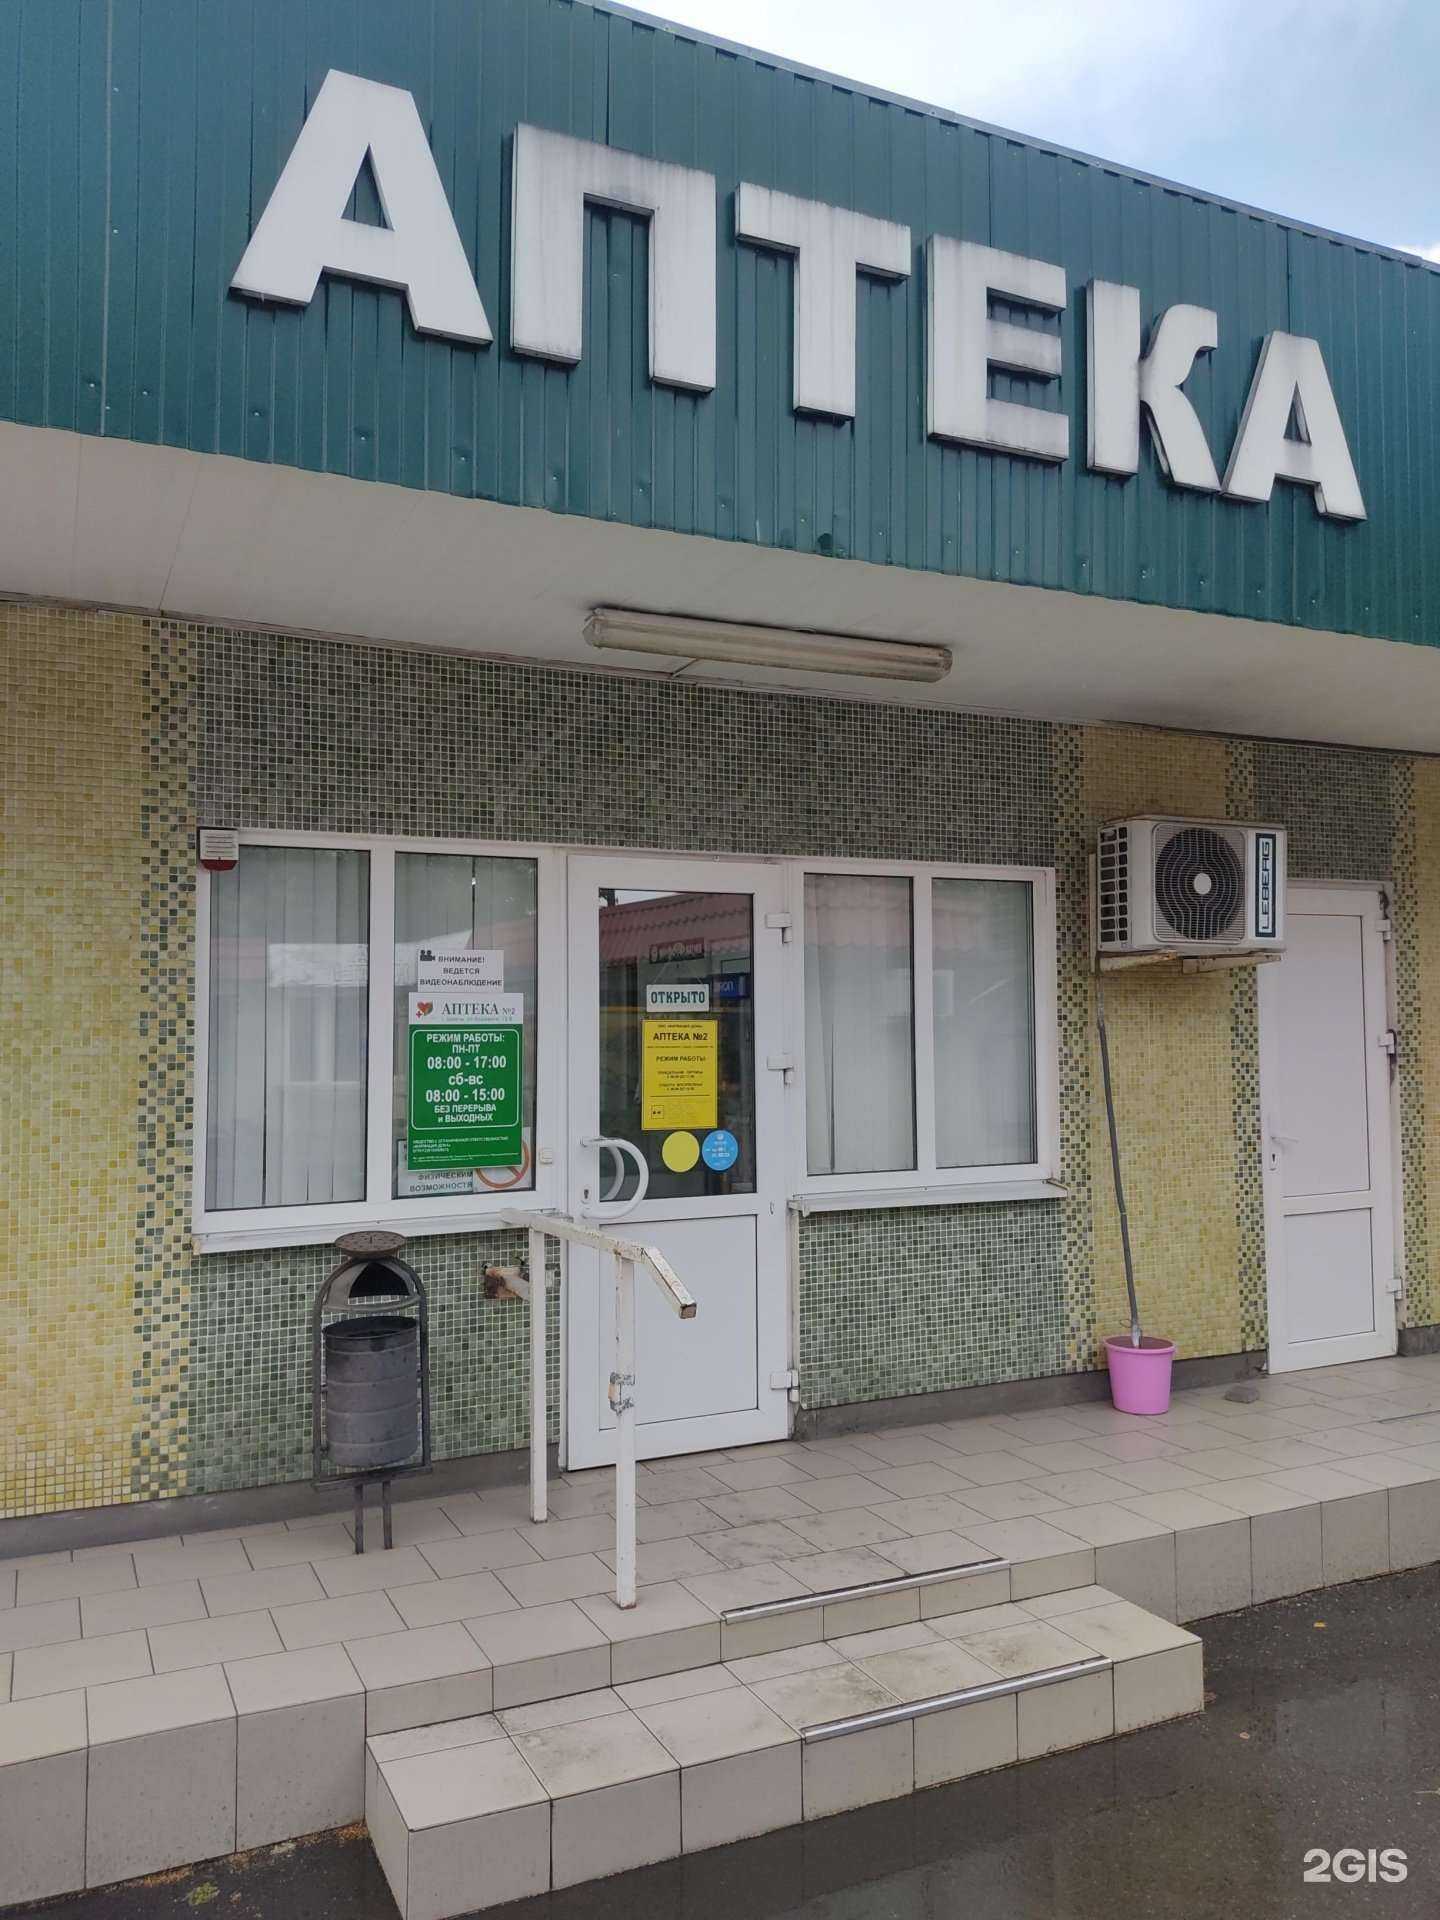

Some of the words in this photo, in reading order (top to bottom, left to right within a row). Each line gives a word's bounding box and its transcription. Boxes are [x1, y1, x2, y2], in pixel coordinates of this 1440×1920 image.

[230, 68, 1367, 522] АПТЕКА
[1261, 841, 1270, 930] LEBERG
[438, 955, 485, 963] ВНИМАНИЕ!
[420, 978, 502, 986] ВИДЕОНАБЛЮДЕНИЕ
[651, 991, 705, 1004] ОТКРЫТО
[441, 1003, 499, 1015] АПТЕКА
[426, 1033, 461, 1043] РЕЖИМ
[463, 1033, 505, 1043] РАБОТЫ:
[653, 1032, 690, 1041] АПТЕКА
[693, 1032, 708, 1040] №2
[452, 1044, 480, 1054] ПН-ПТ
[427, 1056, 461, 1070] 08:00
[473, 1056, 507, 1068] 17:00
[426, 1089, 460, 1102] 08:00
[472, 1088, 505, 1101] 15:00
[434, 1104, 450, 1113] БЕЗ
[452, 1103, 497, 1112] ПЕРЕРЫВА
[445, 1113, 493, 1123] ВЫХОДНЫХ
